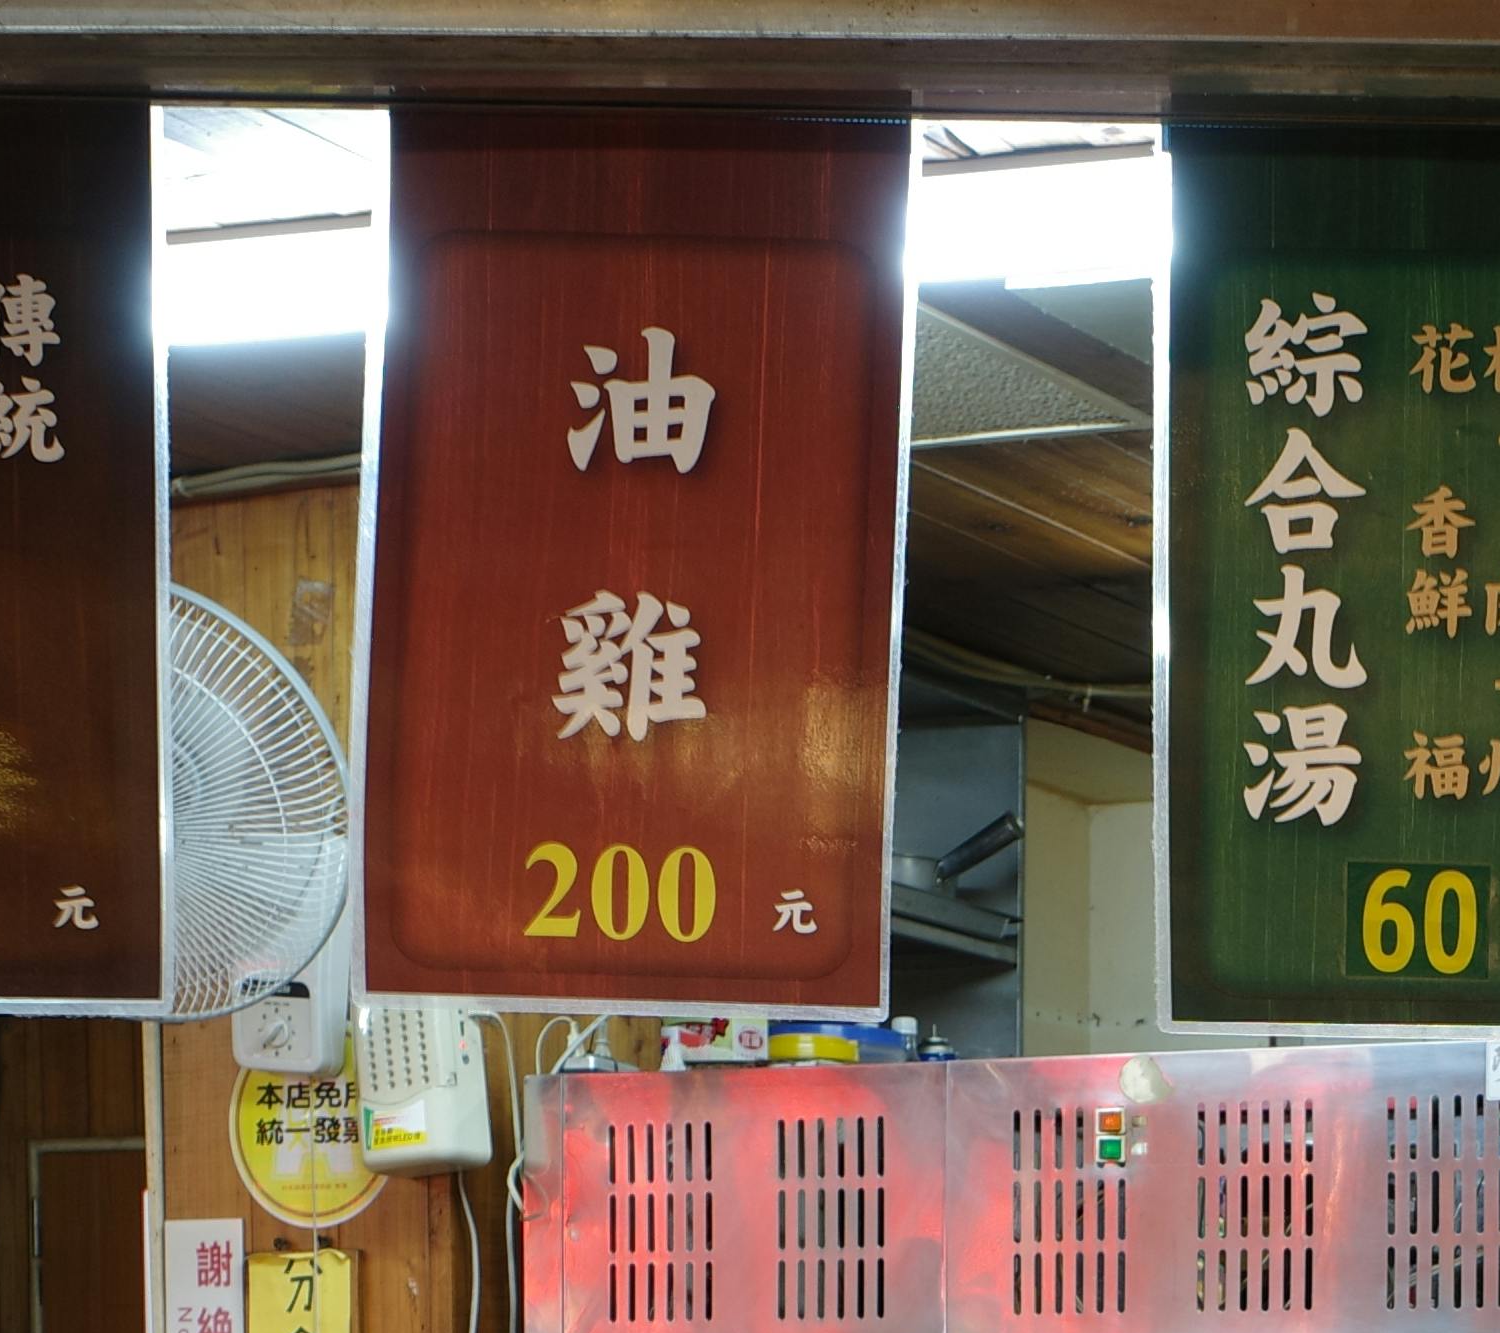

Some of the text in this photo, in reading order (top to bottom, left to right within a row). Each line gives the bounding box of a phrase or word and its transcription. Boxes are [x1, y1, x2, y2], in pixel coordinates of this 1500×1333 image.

[552, 326, 716, 742] 油雞
[1242, 292, 1368, 827] 綜合丸湯
[53, 886, 99, 930] 元
[522, 841, 818, 943] 200 元
[1361, 867, 1478, 975] 60
